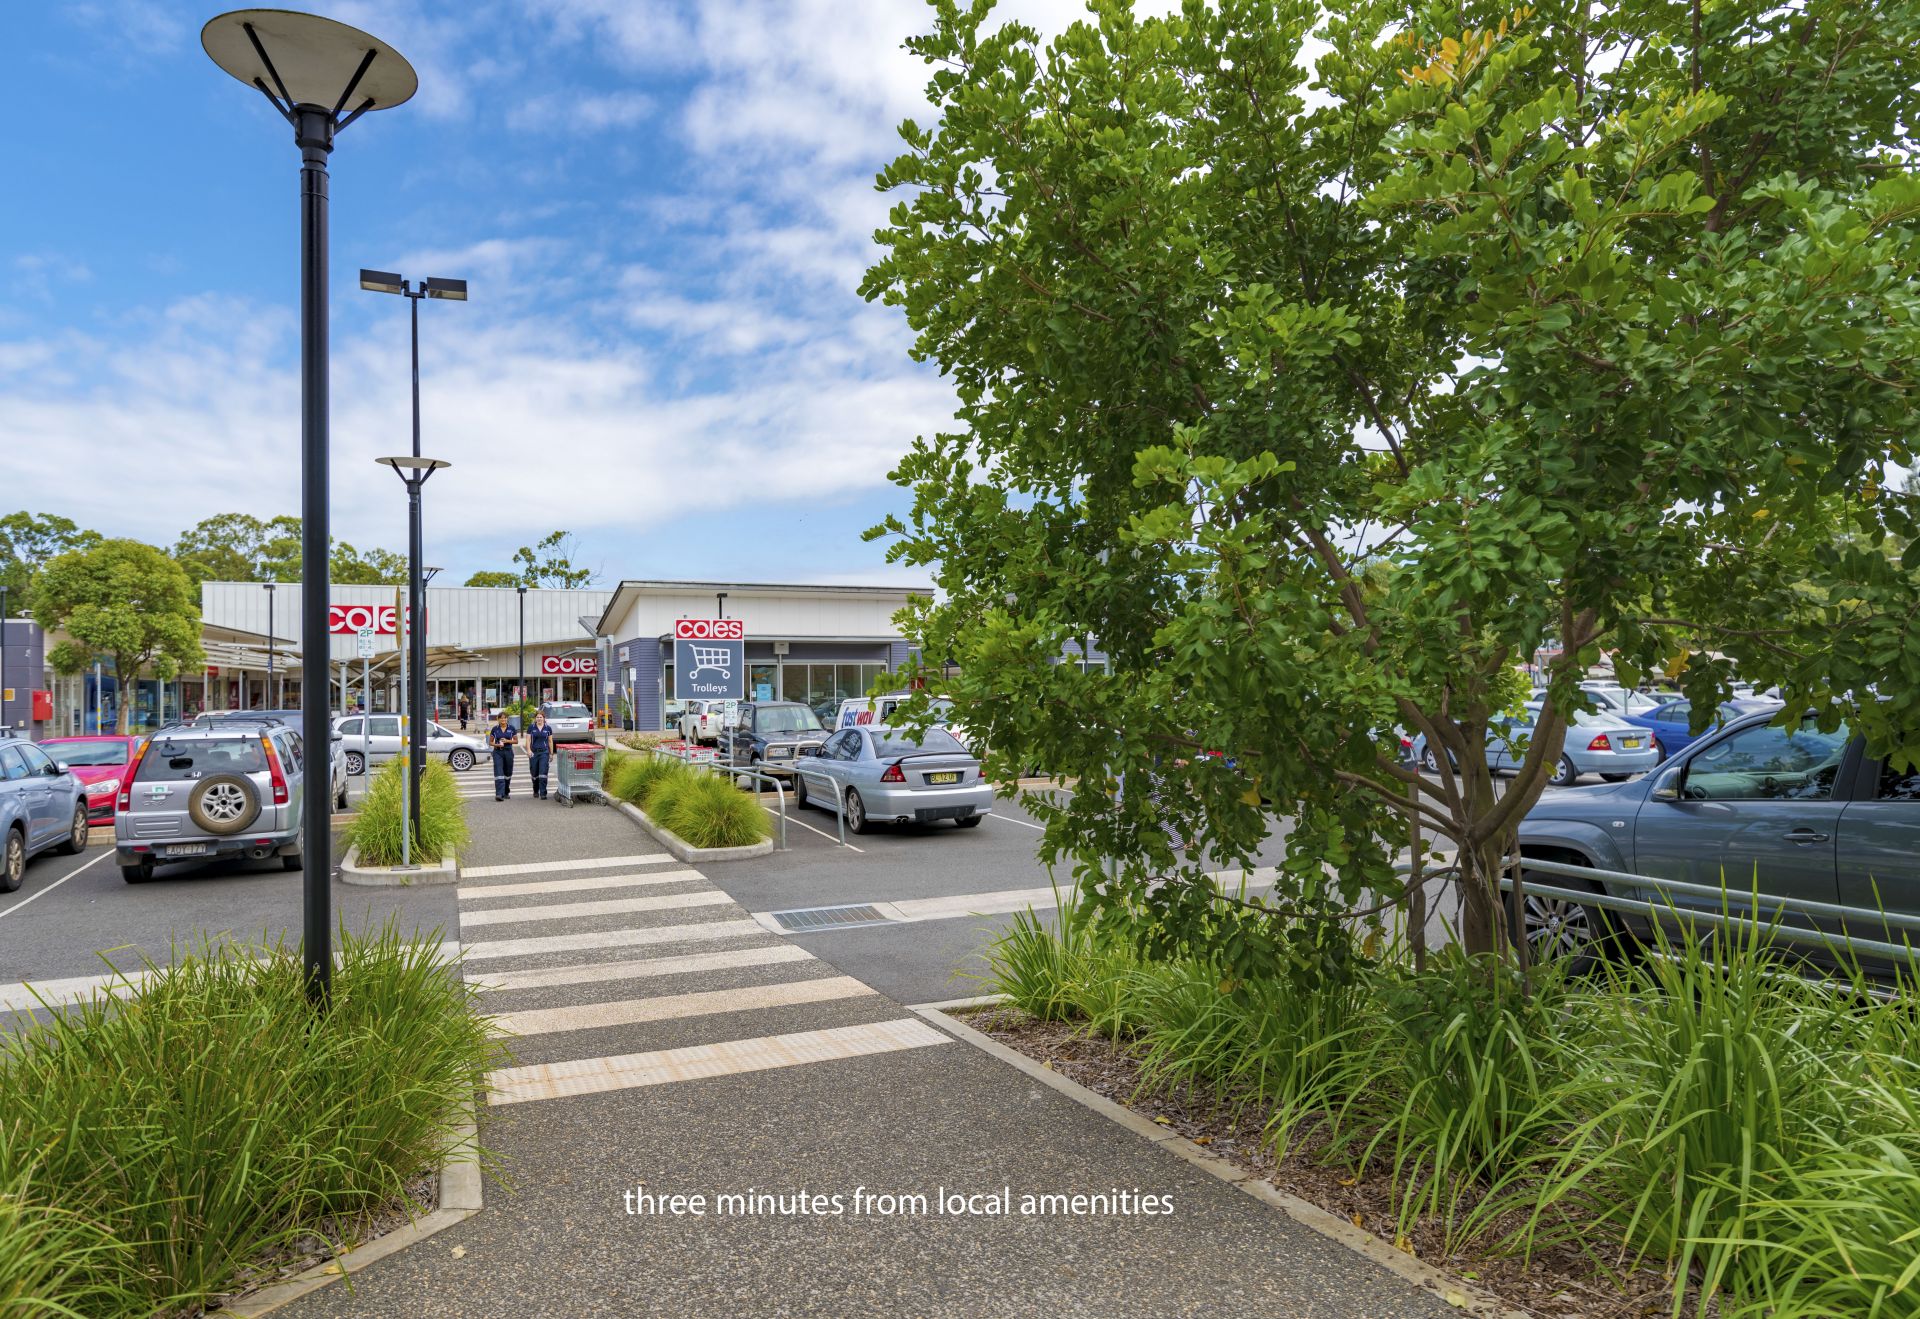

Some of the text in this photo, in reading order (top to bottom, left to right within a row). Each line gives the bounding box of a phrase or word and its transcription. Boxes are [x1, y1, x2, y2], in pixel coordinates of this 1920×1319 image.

[330, 604, 410, 632] cole
[360, 629, 373, 637] 2P
[677, 620, 742, 638] coles
[691, 683, 728, 695] Trolleys
[725, 701, 736, 709] 2P
